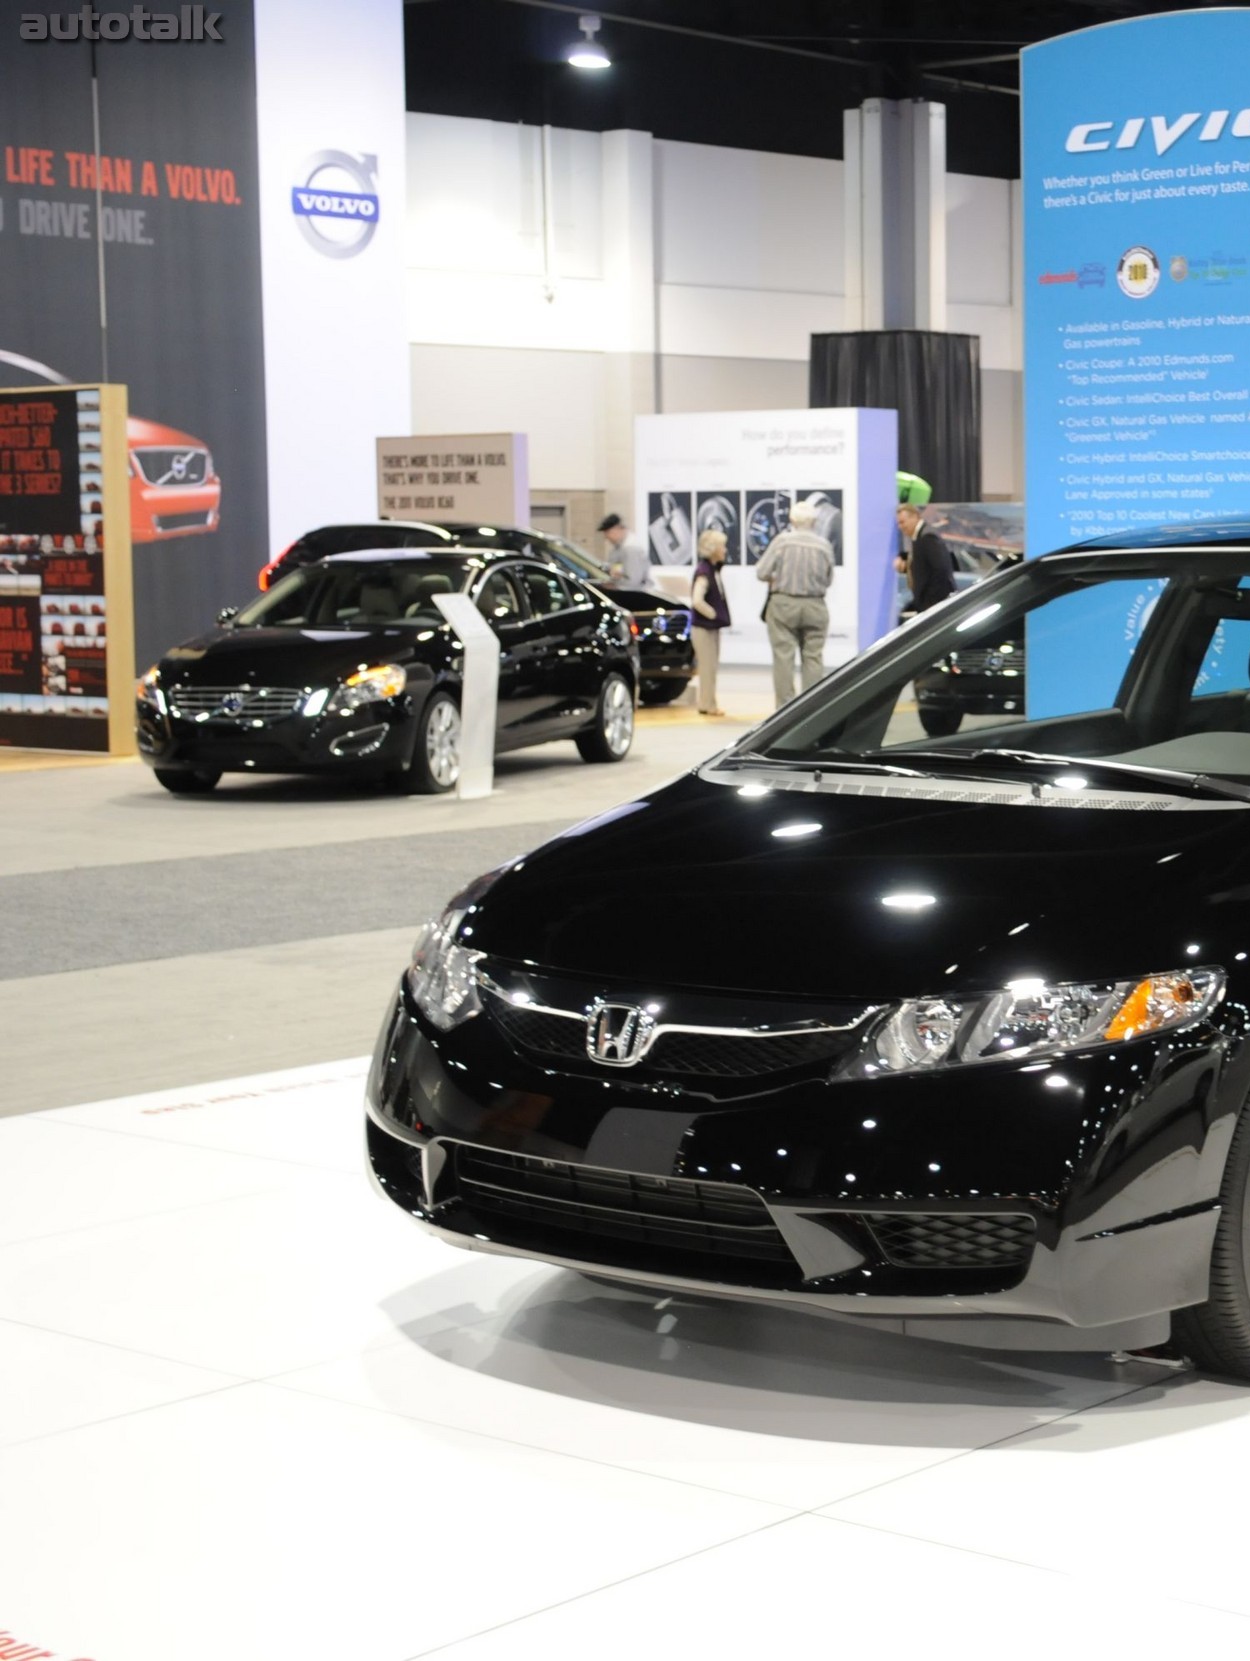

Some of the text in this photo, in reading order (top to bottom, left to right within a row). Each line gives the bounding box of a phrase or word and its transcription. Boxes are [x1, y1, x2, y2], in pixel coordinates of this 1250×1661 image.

[5, 146, 55, 186] LIFE
[65, 151, 133, 196] THAN
[141, 160, 158, 197] A
[1043, 176, 1088, 190] Whether
[1090, 174, 1110, 188] you
[1112, 168, 1139, 184] think
[1141, 168, 1175, 181] Green
[1176, 167, 1187, 178] or
[1190, 164, 1213, 177] Live
[1214, 161, 1230, 175] for
[1079, 195, 1087, 206] a
[1087, 190, 1113, 205] Civic
[1115, 188, 1130, 202] for
[1131, 188, 1152, 204] just
[1153, 185, 1186, 199] about
[1188, 184, 1219, 197] every
[297, 193, 376, 217] VOLVO
[19, 198, 91, 239] DRIVE
[1065, 321, 1109, 334] Available
[1110, 321, 1120, 331] in
[1168, 316, 1201, 330] Hybrid
[1203, 316, 1215, 327] or
[1063, 336, 1141, 350] Gas powertrains
[1065, 359, 1089, 371] Civic
[1127, 356, 1136, 367] A
[1137, 355, 1161, 368] 2010
[1065, 395, 1089, 407] Civic
[1188, 390, 1211, 402] Best
[1212, 389, 1249, 401] Overall
[1066, 416, 1090, 428] Civic
[1111, 414, 1147, 426] Natural
[1148, 413, 1168, 426] Gas
[1169, 412, 1206, 425] Vehicle
[1209, 411, 1246, 423] named
[1066, 453, 1090, 465] Civic
[1066, 473, 1090, 485] Civic
[1091, 473, 1126, 487] Hybrid
[1127, 472, 1146, 484] and
[1167, 471, 1203, 484] Natural
[1205, 471, 1225, 483] Gas
[1065, 489, 1089, 500] Lane
[1090, 487, 1138, 501] Approved
[1140, 488, 1150, 499] in
[1151, 488, 1179, 499] some
[1096, 509, 1115, 522] Top
[1129, 508, 1167, 521] Coolest
[1168, 508, 1191, 520] New
[1069, 524, 1084, 537] by
